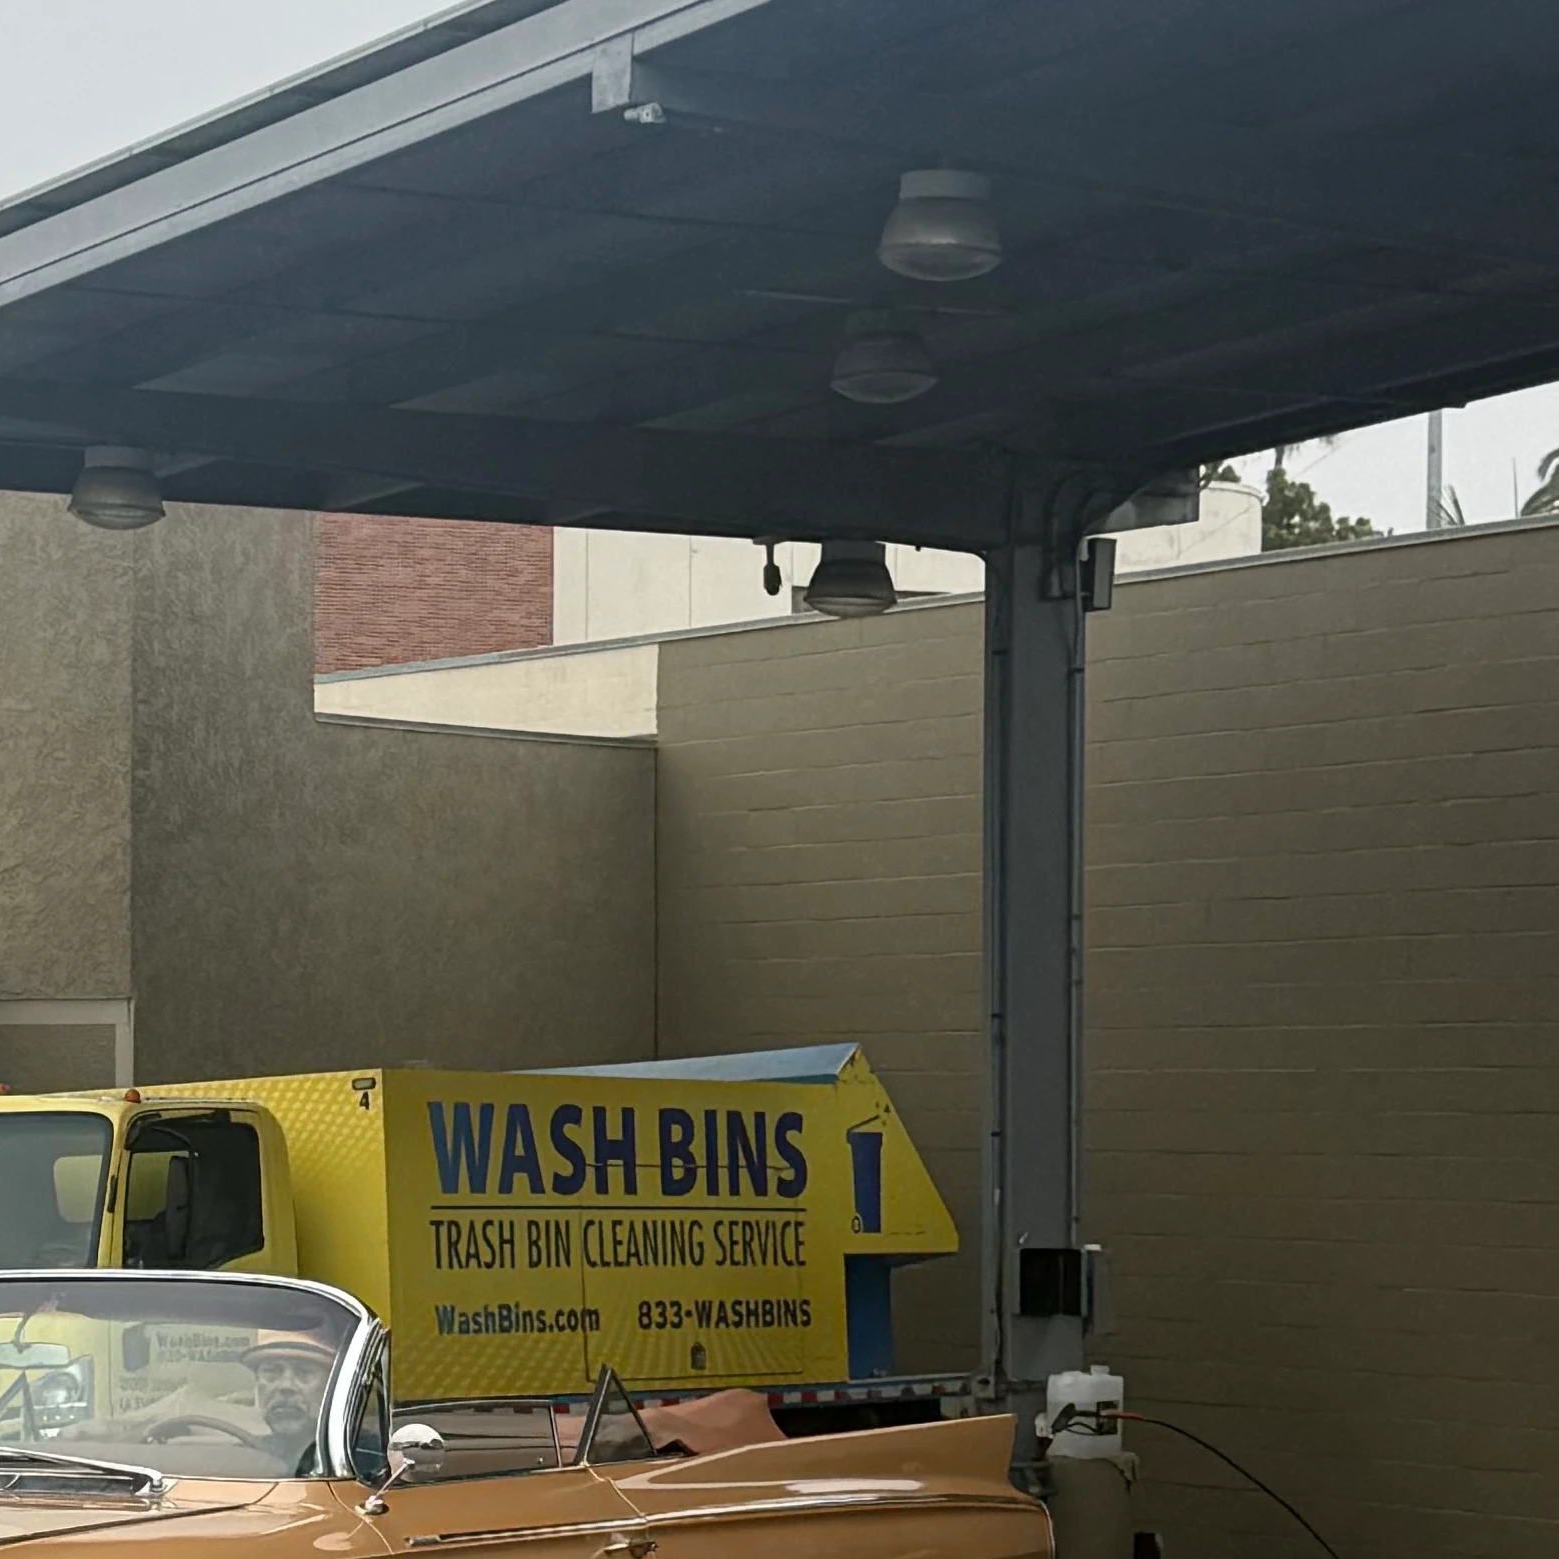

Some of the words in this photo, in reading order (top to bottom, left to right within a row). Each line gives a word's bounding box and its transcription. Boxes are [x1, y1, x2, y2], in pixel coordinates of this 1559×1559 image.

[428, 1100, 638, 1196] WASH
[658, 1108, 808, 1199] BINS
[429, 1219, 516, 1270] TRASH
[526, 1219, 571, 1269] BIN
[582, 1219, 705, 1269] CLEANING
[712, 1219, 807, 1268] SERVICE
[435, 1303, 600, 1336] WashBins.com
[637, 1298, 812, 1331] 833-WASHBINS
